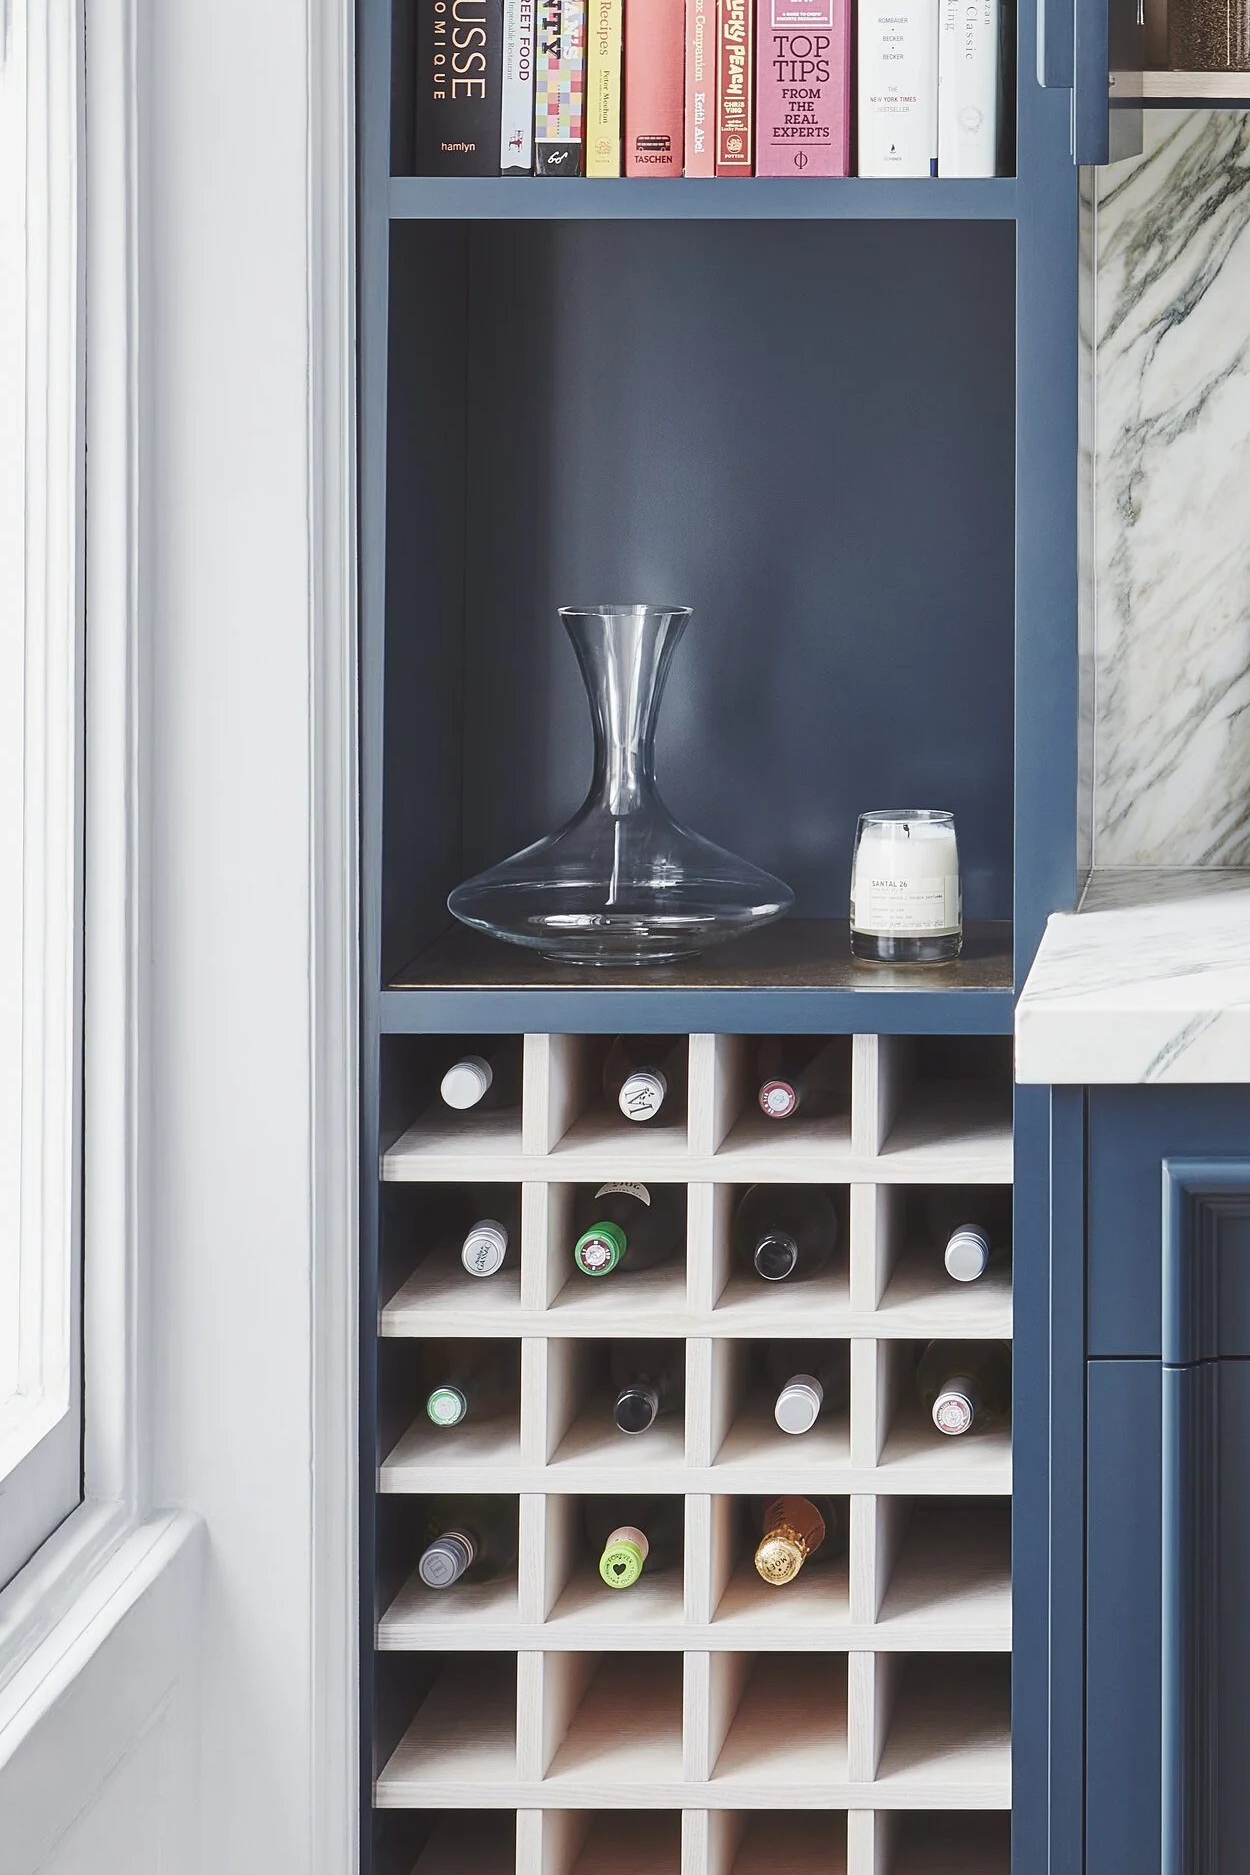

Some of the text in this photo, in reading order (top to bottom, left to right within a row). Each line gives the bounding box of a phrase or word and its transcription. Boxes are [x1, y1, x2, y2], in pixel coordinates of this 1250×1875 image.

[506, 1, 515, 41] Improbable
[596, 1, 612, 56] Recipes
[965, 6, 978, 60] Classic
[518, 37, 531, 81] FOOD
[693, 15, 706, 82] Companion
[773, 35, 830, 58] TOP
[506, 42, 514, 81] Restaurant
[725, 45, 746, 95] PEACH
[773, 59, 830, 83] TIPS
[781, 88, 821, 99] FROM
[788, 101, 815, 112] THE
[602, 92, 610, 124] Meehan
[784, 114, 819, 125] REAL
[694, 92, 706, 154] Keith Abel
[772, 127, 830, 138] EXPERTS
[441, 140, 476, 152] hamlyn
[634, 155, 673, 164] TASCHEN
[607, 1553, 633, 1564] FOREVER
